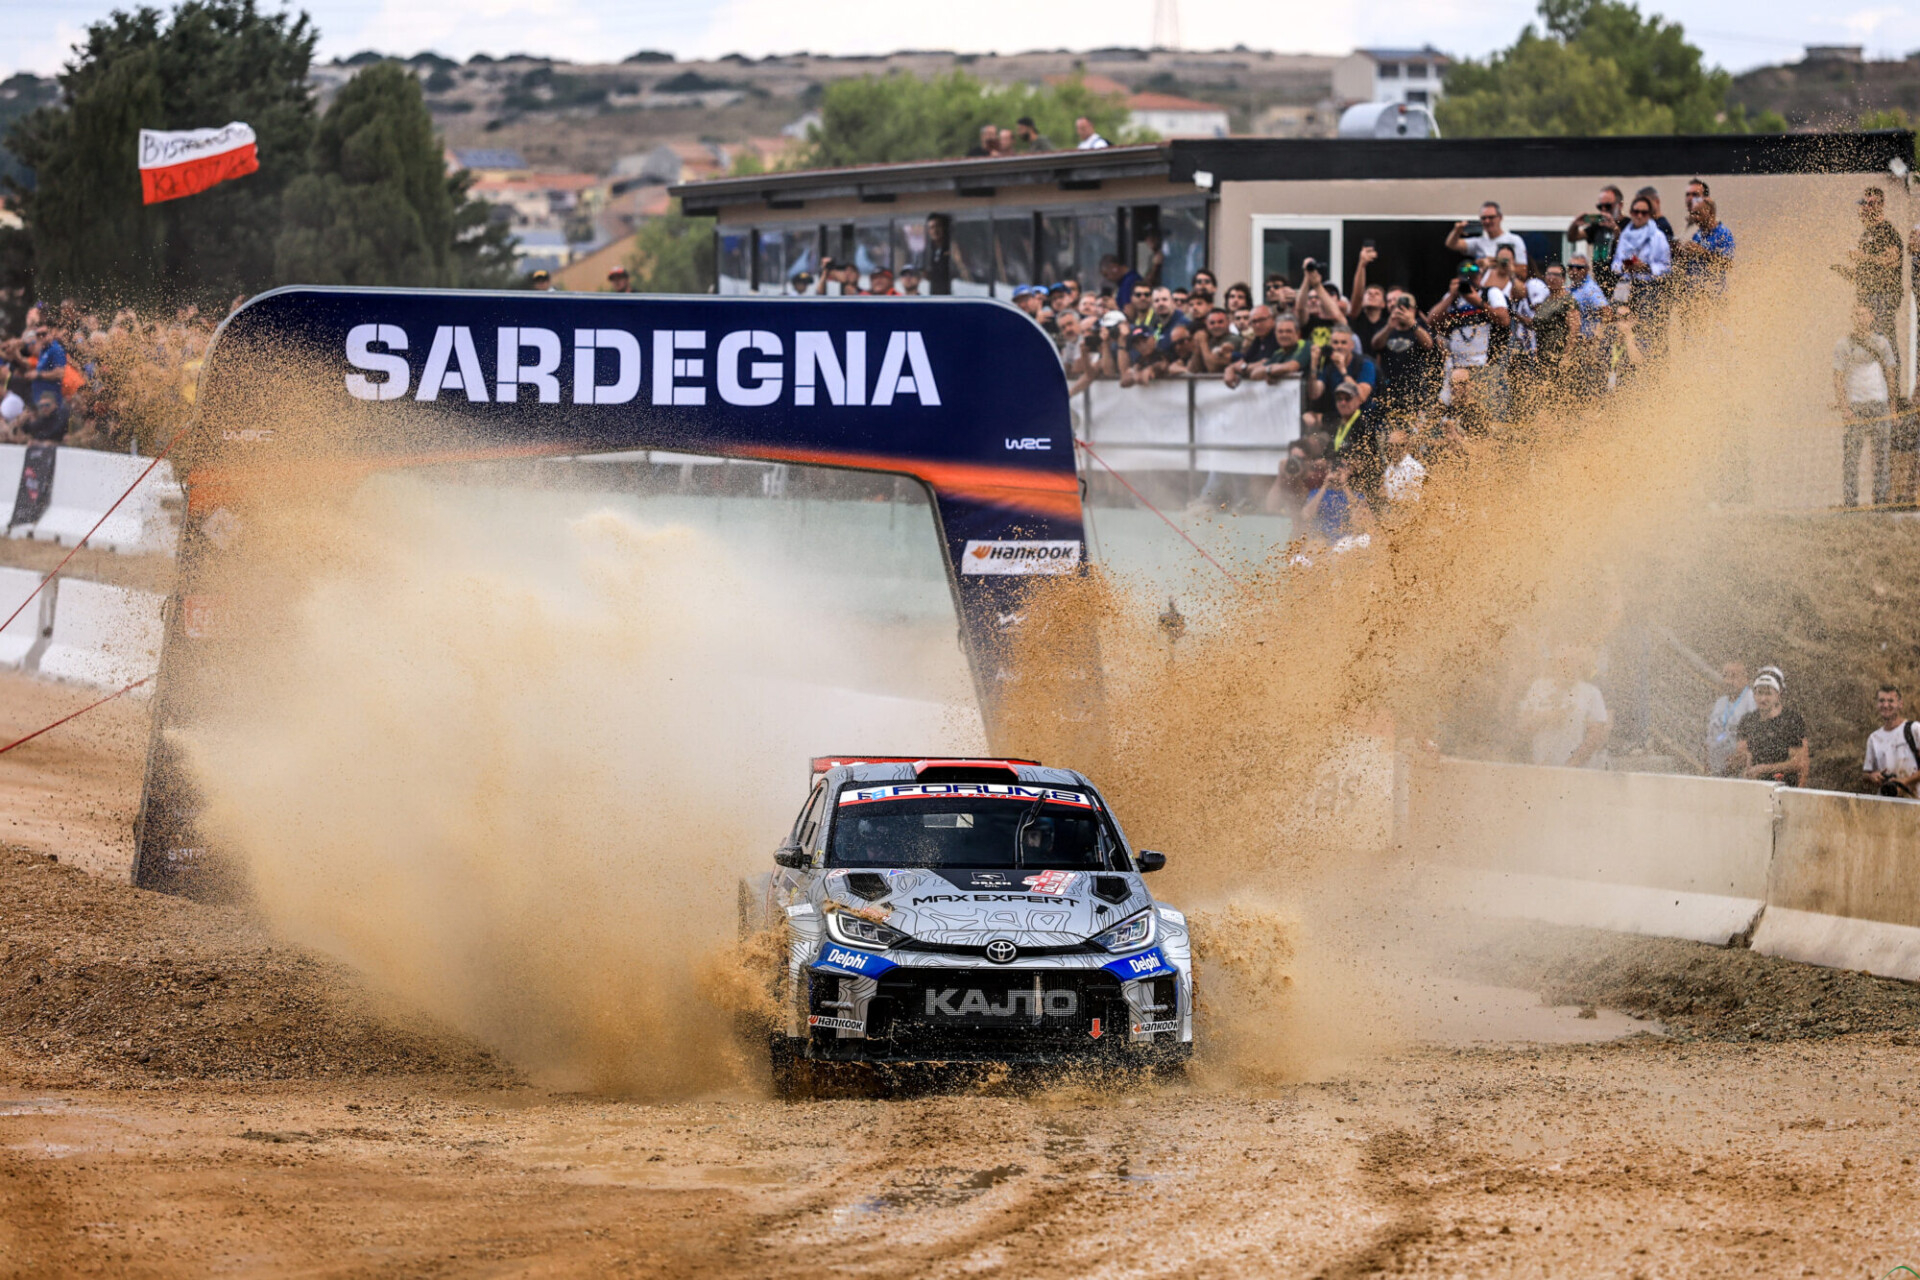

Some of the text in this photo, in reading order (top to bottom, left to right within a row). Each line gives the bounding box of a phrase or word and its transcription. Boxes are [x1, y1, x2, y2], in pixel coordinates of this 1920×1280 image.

[345, 323, 942, 406] SARDEGNA
[1005, 438, 1051, 450] WRC
[892, 784, 1081, 802] FORUM8
[912, 894, 1080, 908] MAX EXPERT
[827, 948, 869, 970] Delphi
[1129, 952, 1162, 974] Delphi
[925, 988, 1078, 1017] KAJTO
